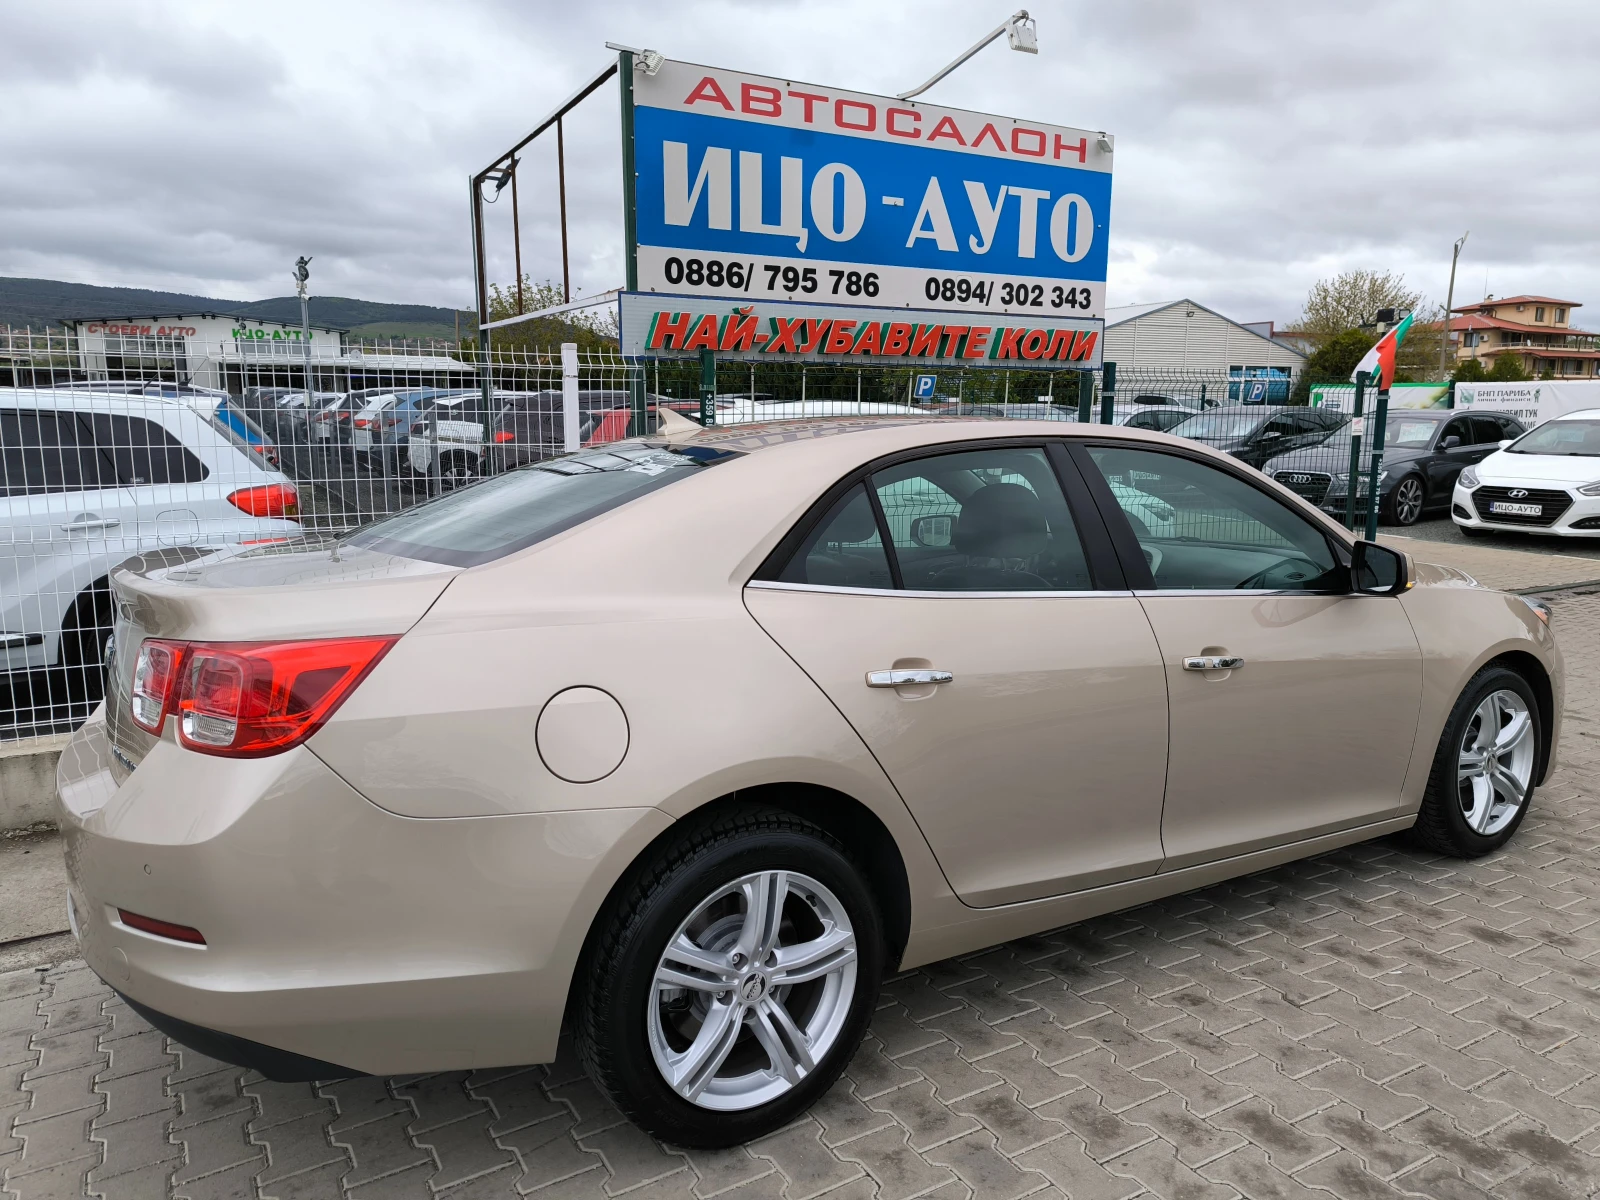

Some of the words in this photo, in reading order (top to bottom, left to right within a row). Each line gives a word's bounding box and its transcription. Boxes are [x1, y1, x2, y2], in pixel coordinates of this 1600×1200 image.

[683, 76, 1087, 163] АВТОСАЛОН
[664, 256, 753, 292] 0886/
[763, 264, 818, 294] 795
[828, 269, 880, 298] 786
[924, 277, 994, 307] 0894/
[1000, 282, 1044, 307] 302
[1050, 286, 1092, 310] 343
[87, 323, 151, 335] СТОЕВИ
[156, 325, 197, 337] АУТО
[645, 306, 991, 358] НАЙ-ХУБАВИТЕ
[990, 327, 1098, 361] КОЛИ
[1497, 389, 1531, 397] ПАРИБА
[705, 393, 714, 416] +359
[1524, 409, 1538, 418] ТУК
[1494, 503, 1541, 514] ИЦО-АУТО
